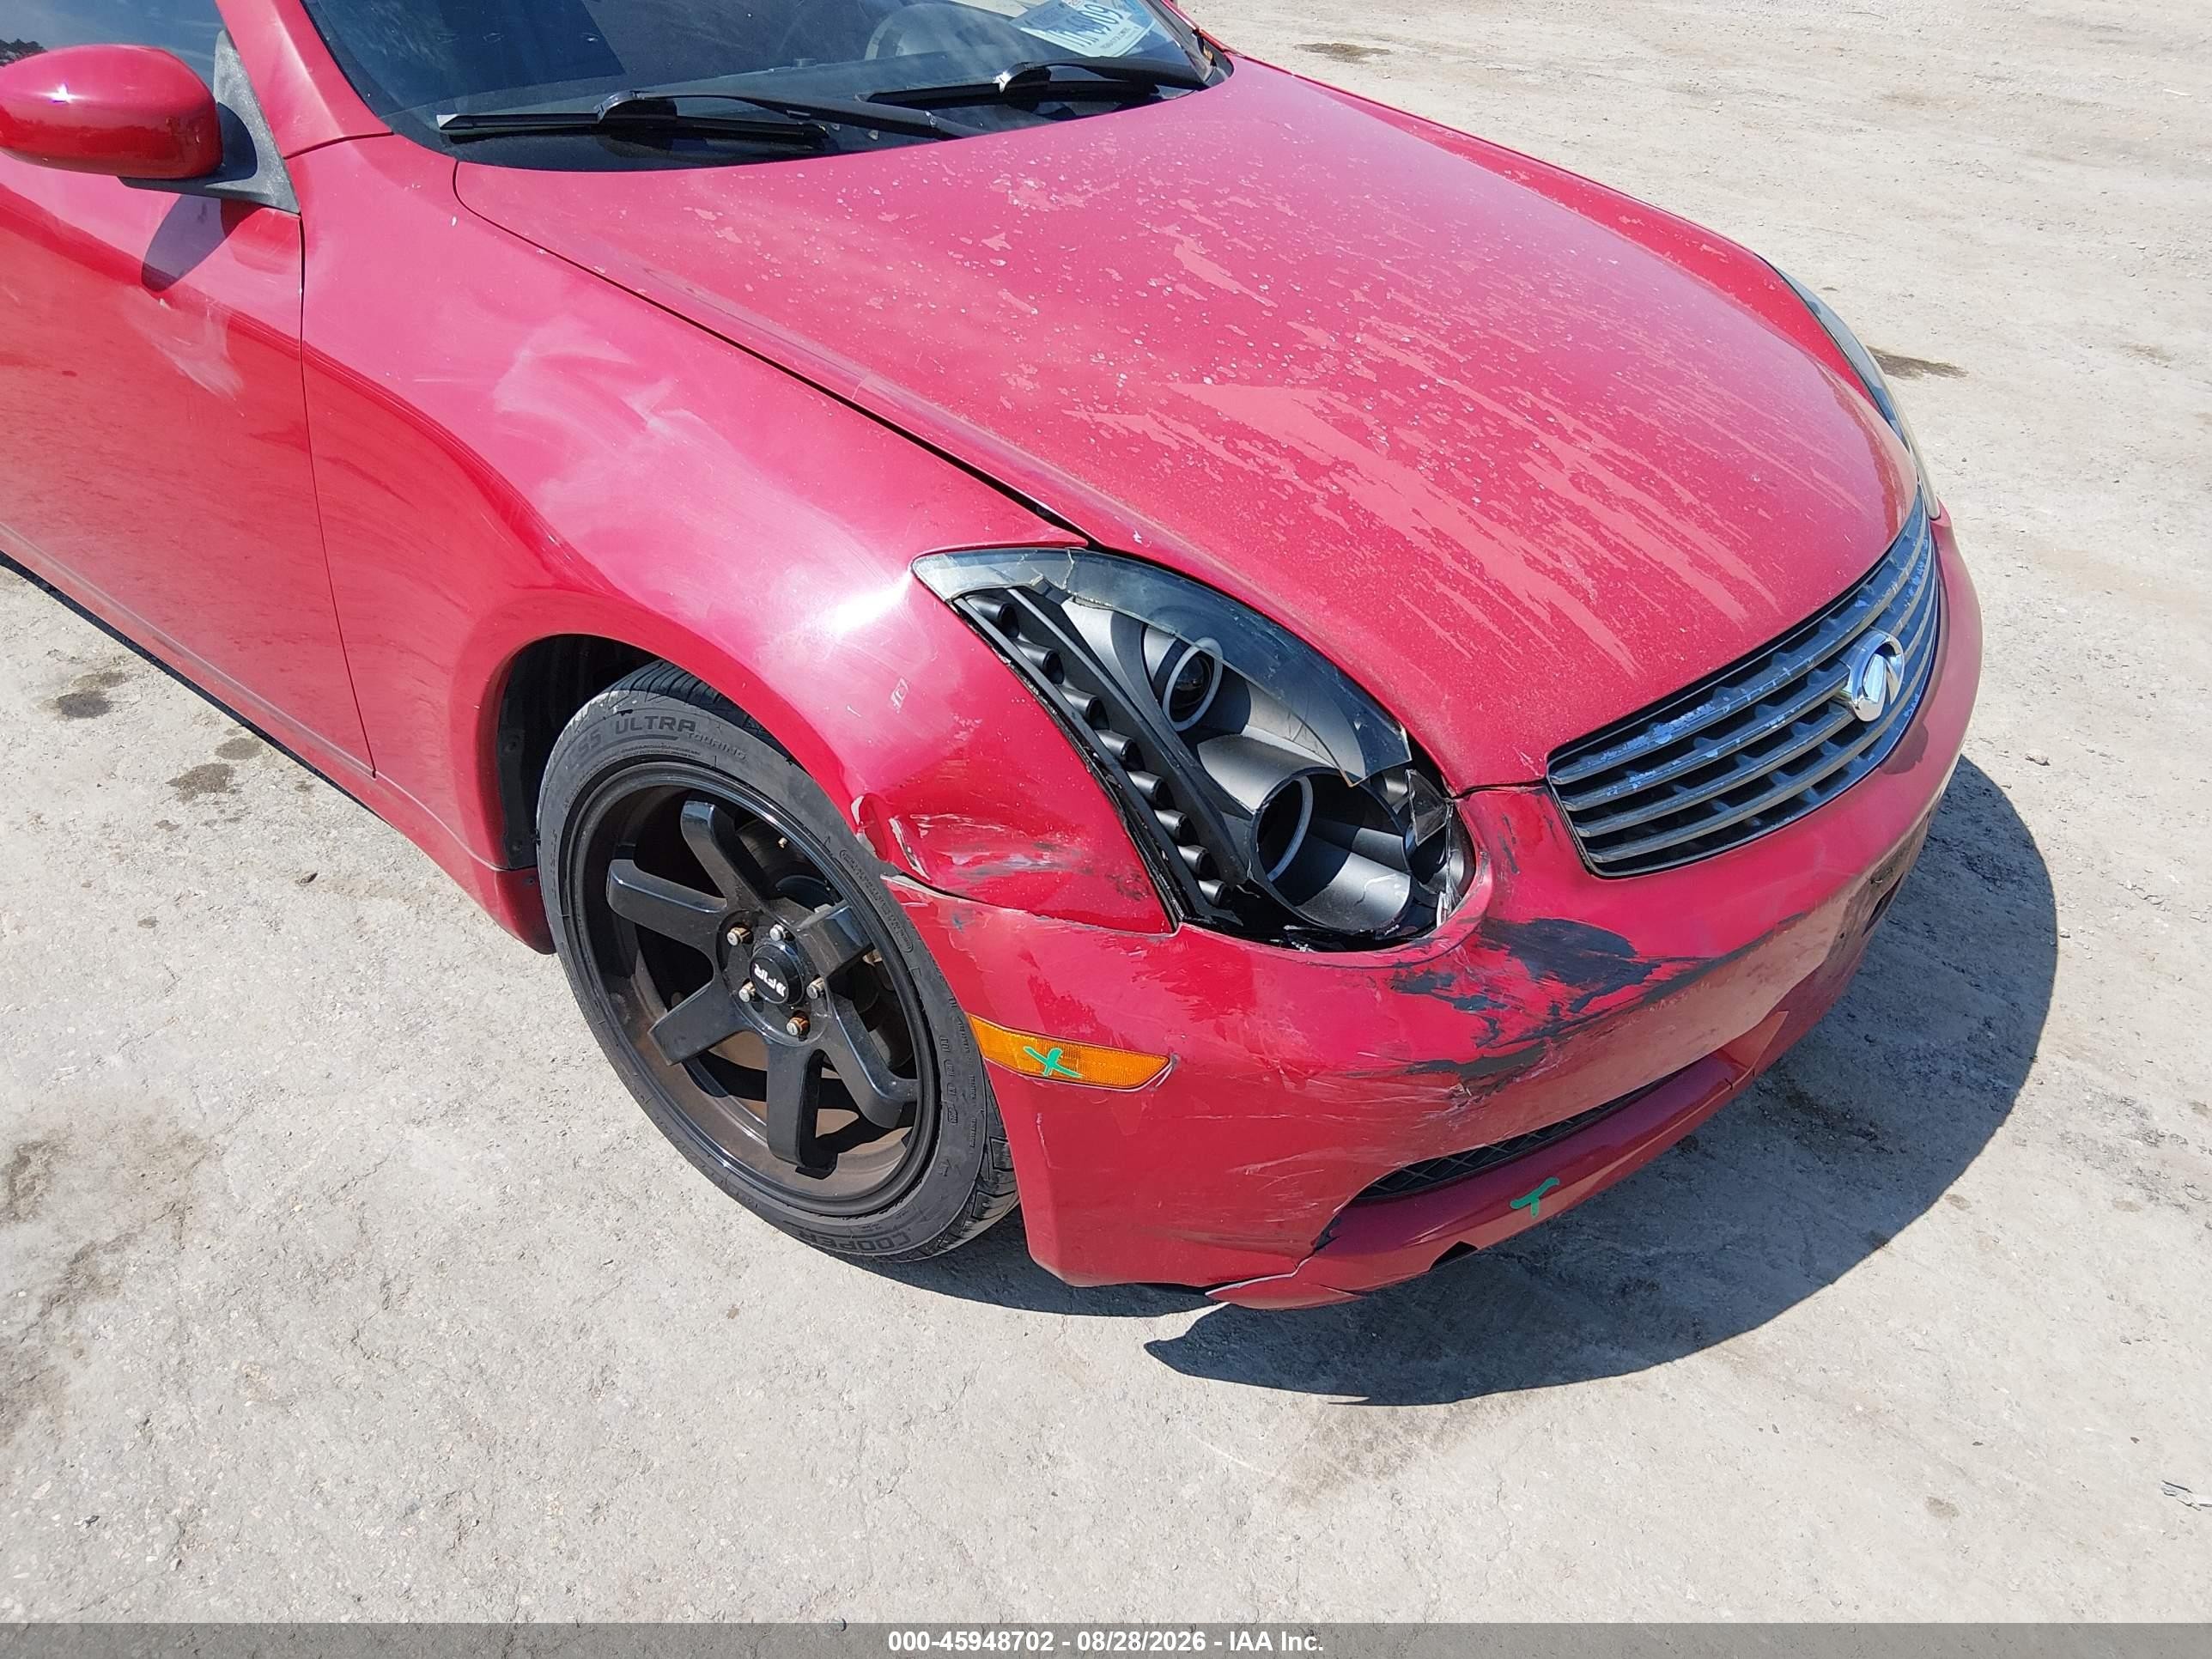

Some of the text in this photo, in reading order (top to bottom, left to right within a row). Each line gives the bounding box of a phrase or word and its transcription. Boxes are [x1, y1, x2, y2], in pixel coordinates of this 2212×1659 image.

[615, 715, 696, 734] ULTRA
[685, 732, 749, 761] TOURING
[798, 1229, 920, 1254] COOPER
